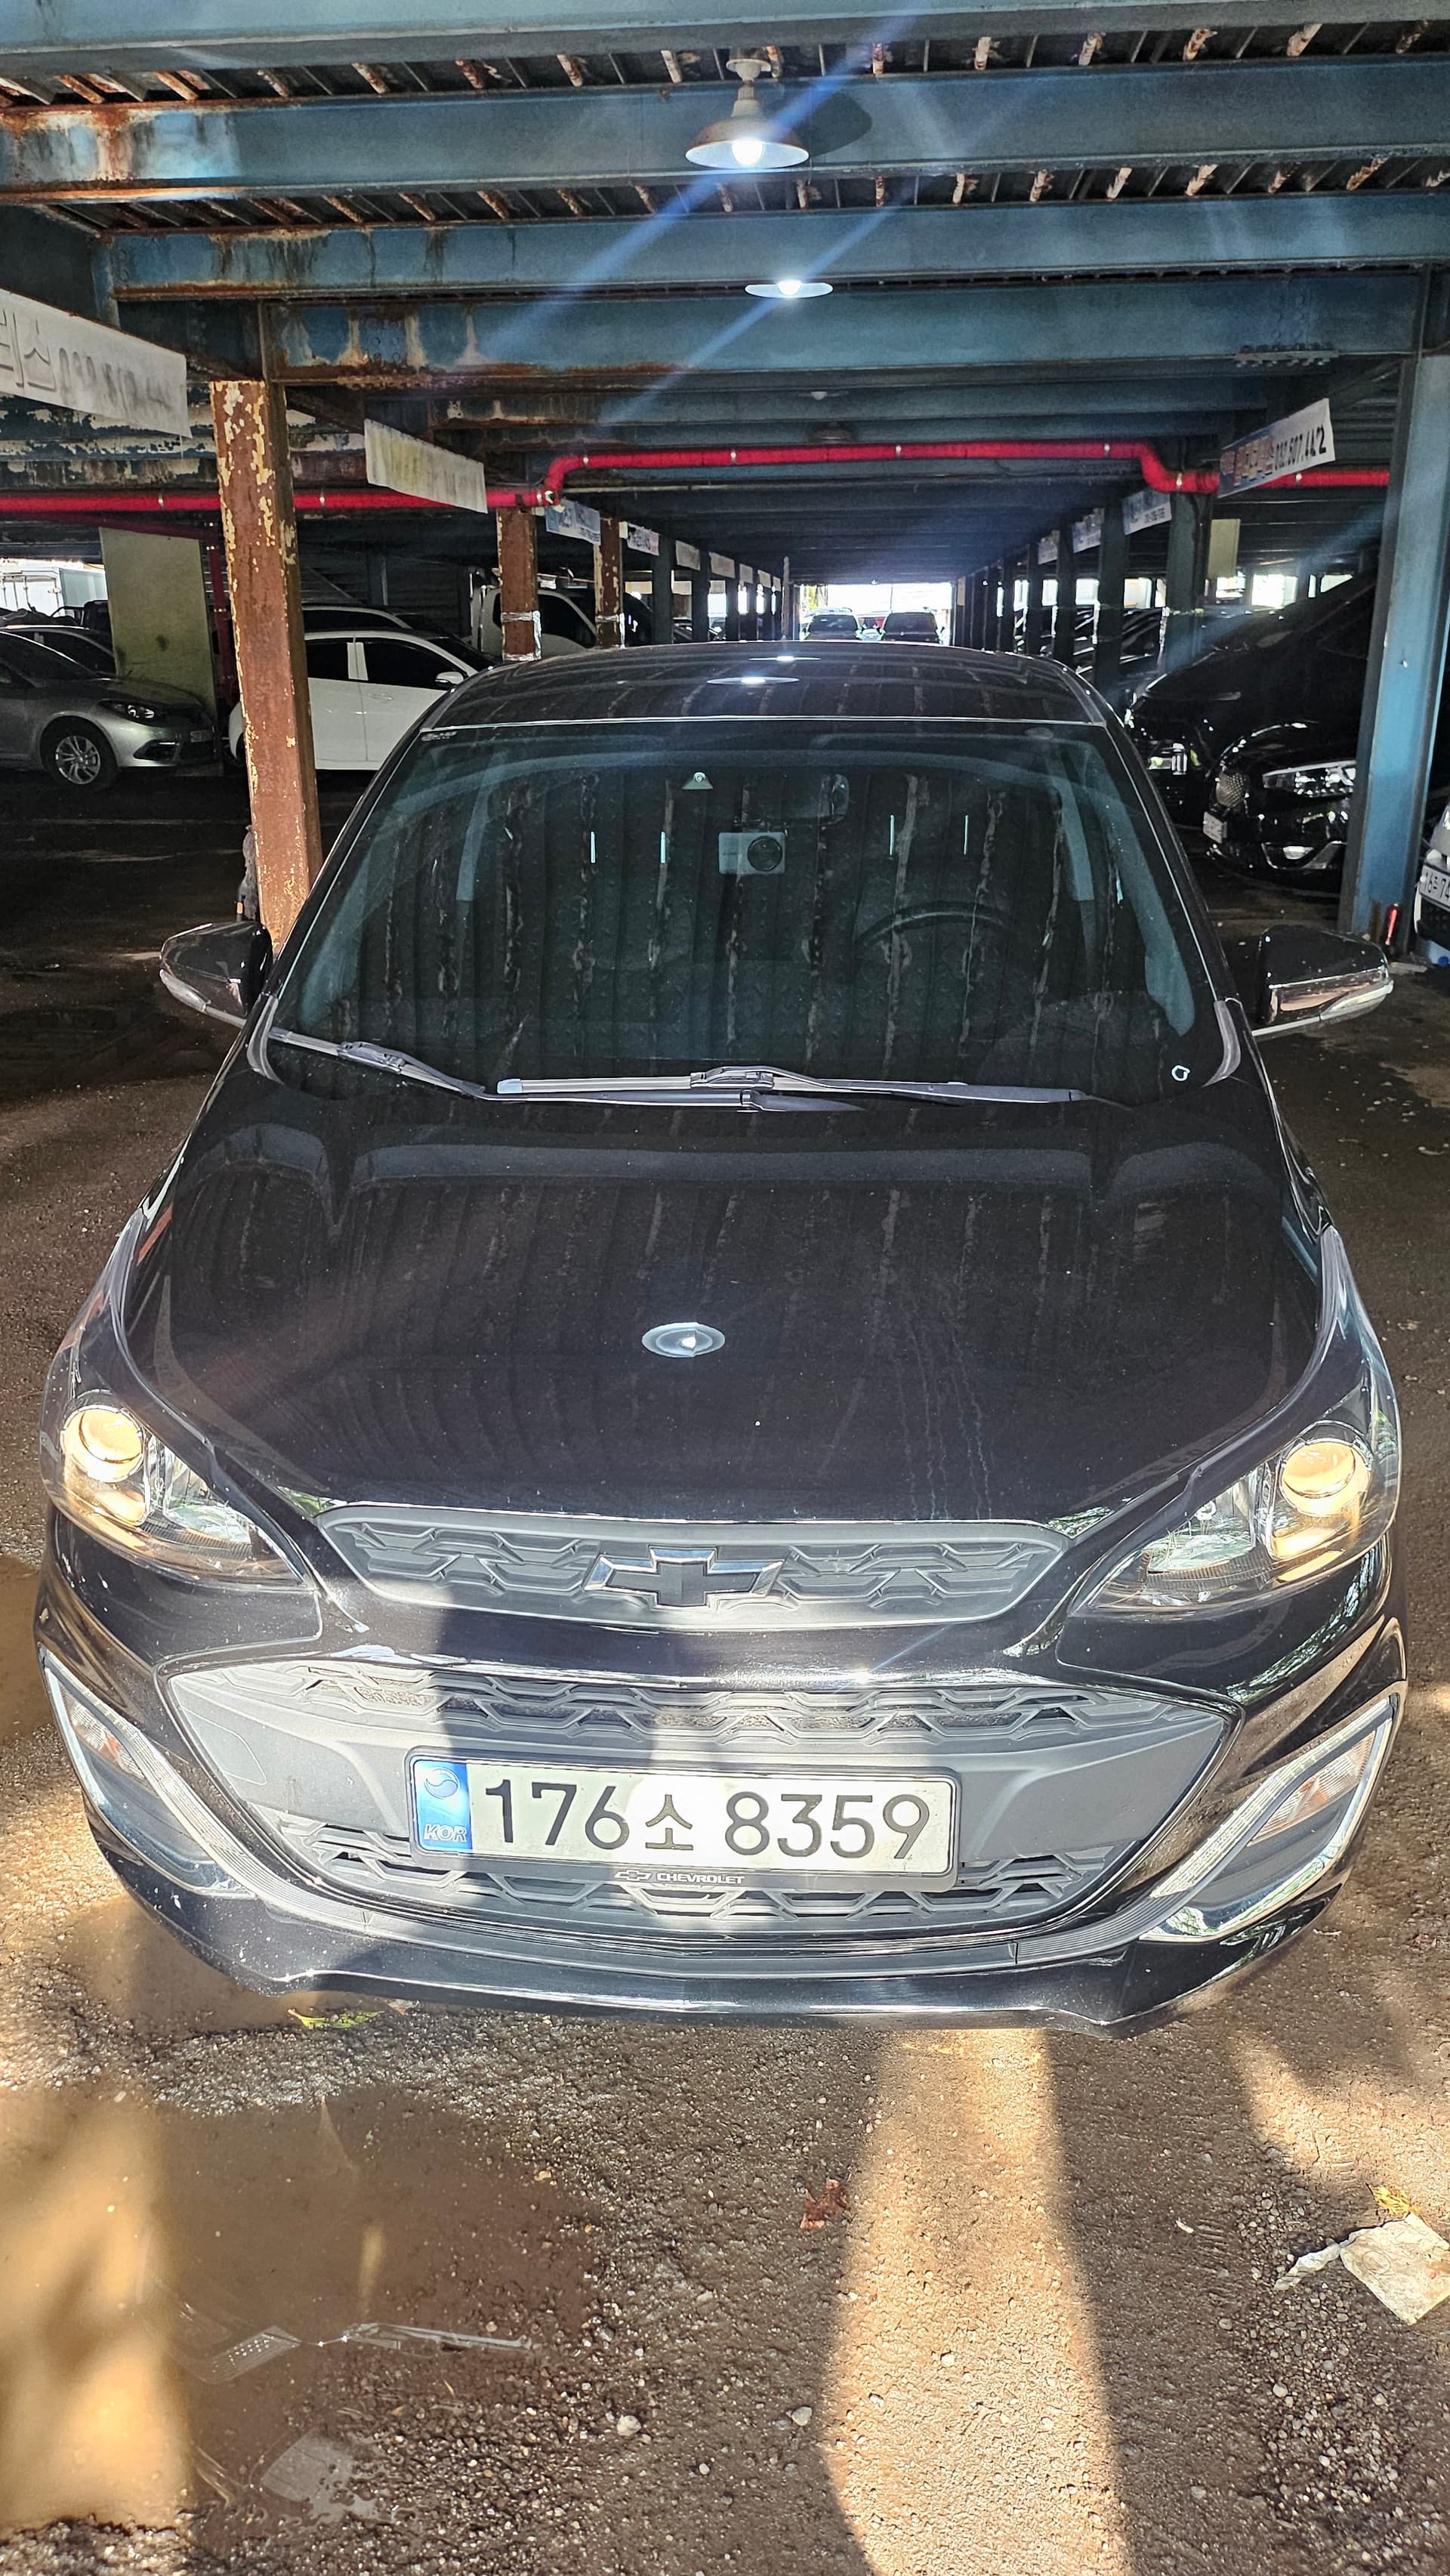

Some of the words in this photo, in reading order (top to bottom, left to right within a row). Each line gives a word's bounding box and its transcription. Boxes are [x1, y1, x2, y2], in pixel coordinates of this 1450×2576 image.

[486, 1779, 693, 1850] 176소
[724, 1791, 930, 1859] 8359
[423, 1823, 467, 1842] KOR
[656, 1872, 745, 1885] CHEVROLET
